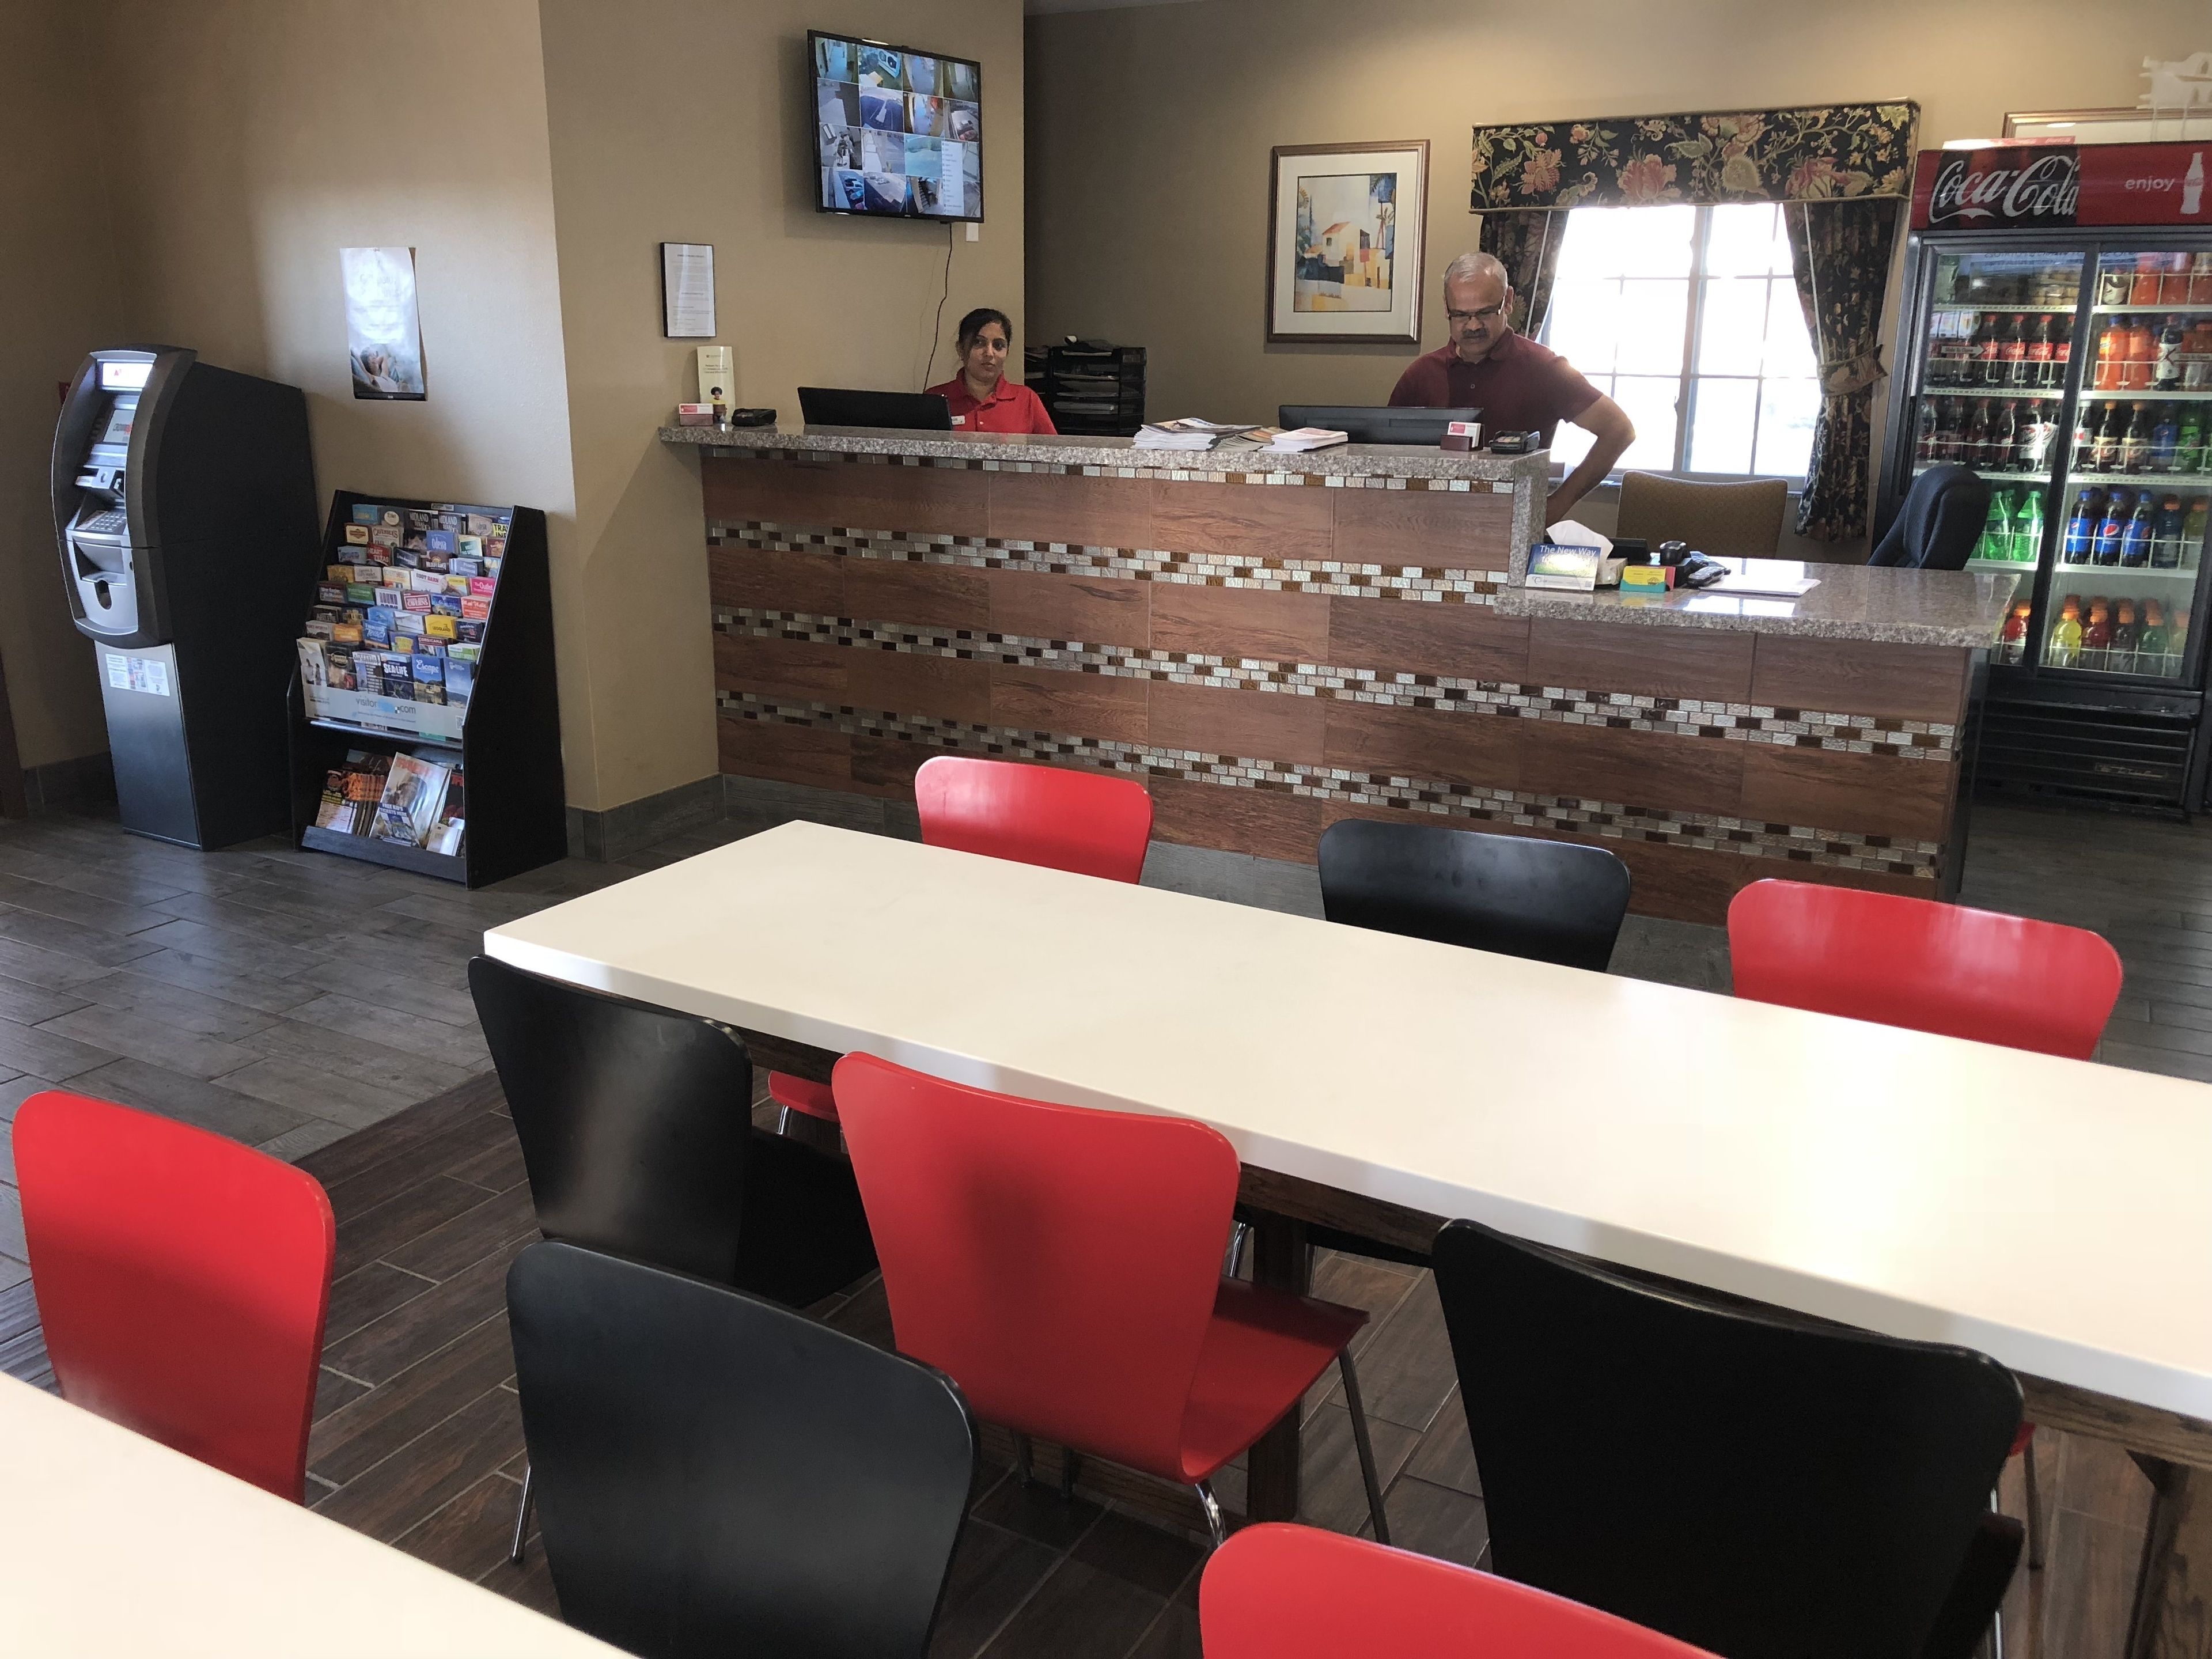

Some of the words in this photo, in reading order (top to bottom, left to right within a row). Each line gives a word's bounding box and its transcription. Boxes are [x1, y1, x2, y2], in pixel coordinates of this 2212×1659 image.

[1929, 154, 2080, 223] Coca-Cola
[2124, 176, 2175, 191] enjoy
[431, 537, 447, 551] Odessa
[1540, 545, 1556, 554] The
[1558, 546, 1577, 555] New
[1578, 547, 1597, 558] Way
[355, 695, 378, 708] visitor
